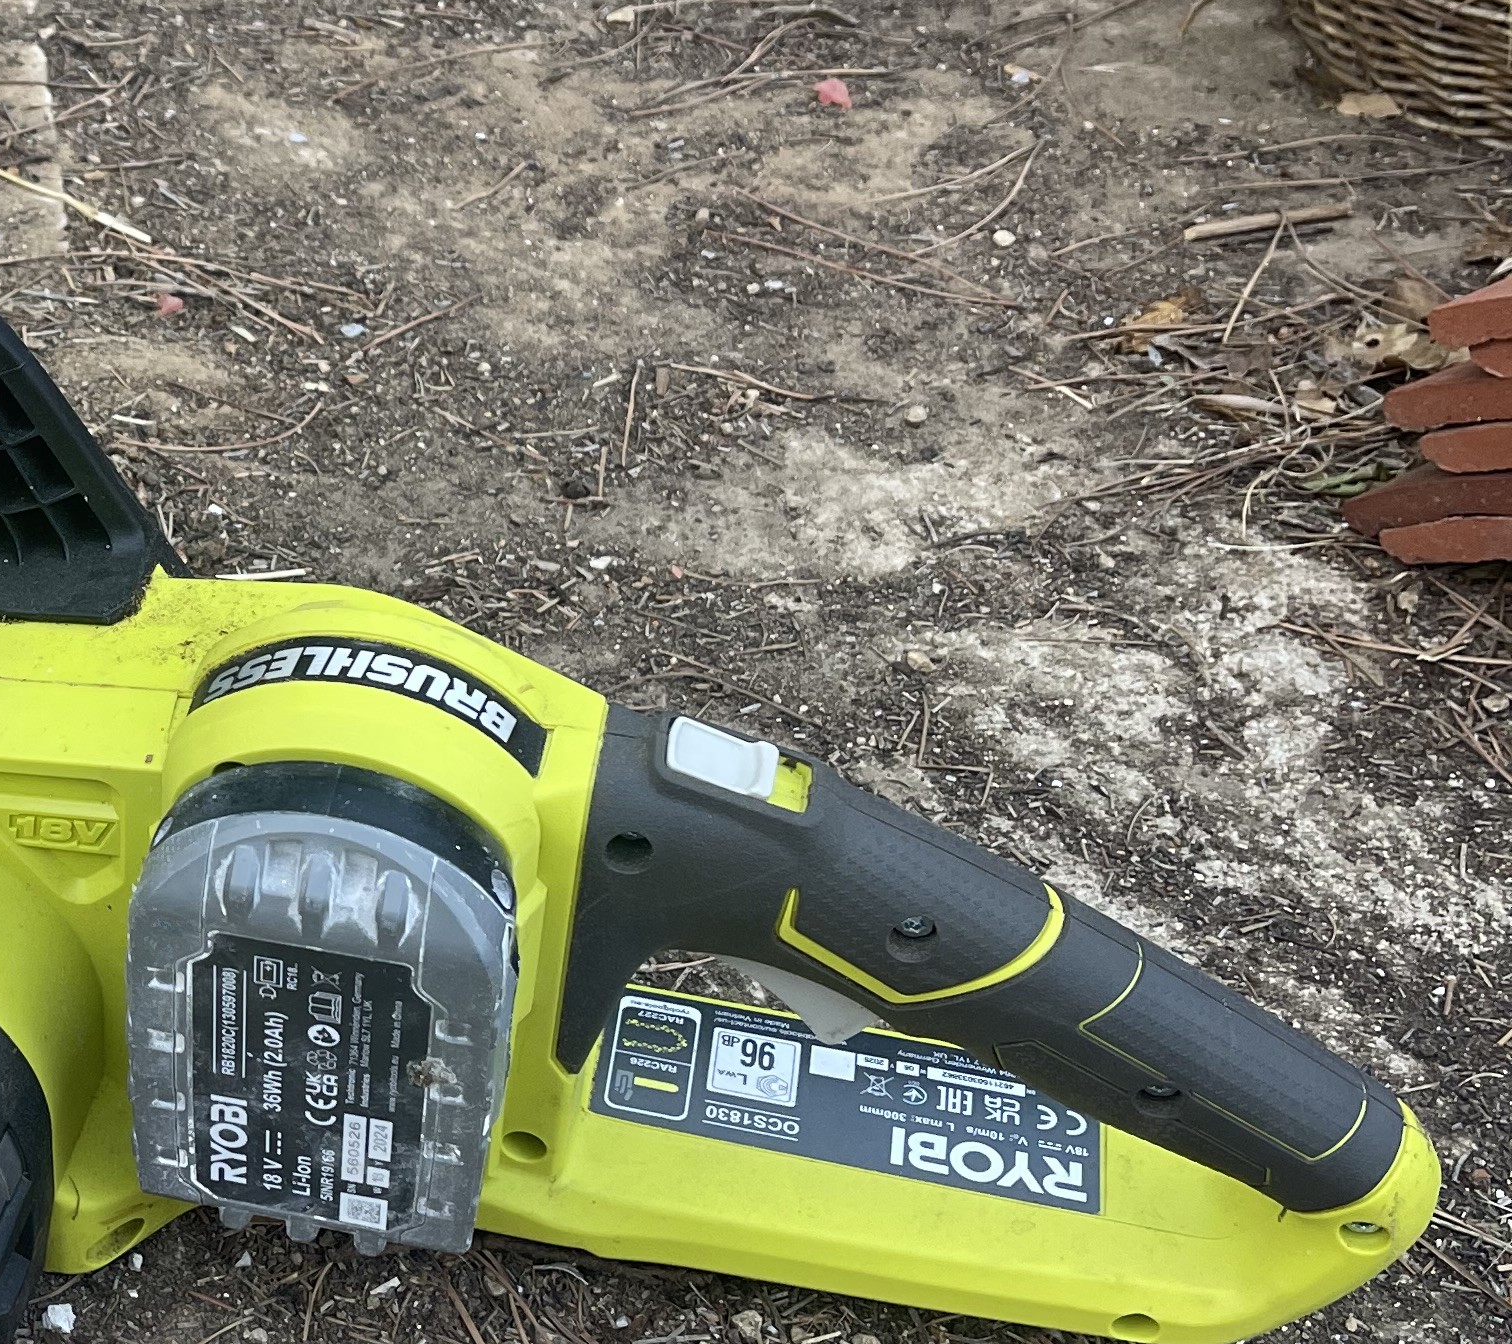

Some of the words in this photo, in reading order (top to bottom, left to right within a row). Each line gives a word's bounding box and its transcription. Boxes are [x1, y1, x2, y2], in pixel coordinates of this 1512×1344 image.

[202, 646, 517, 743] BRUSHLESS
[10, 814, 113, 848] 18V
[392, 1001, 403, 1020] China
[638, 1010, 684, 1024] RAC227
[715, 1009, 752, 1022] Vietnam
[764, 1018, 790, 1028] Made
[264, 1012, 289, 1067] (2.0Ah)
[391, 1029, 401, 1048] Made
[721, 1034, 740, 1048] dB
[741, 1039, 775, 1070] 96
[897, 1050, 939, 1063] Germany
[629, 1056, 677, 1073] RAC226
[263, 1071, 282, 1112] 36Wh
[360, 1074, 370, 1108] Industries
[705, 1105, 800, 1135] OCS1830
[859, 1105, 907, 1122] 300mm
[910, 1115, 942, 1128] max:
[985, 1107, 1020, 1125] UK
[946, 1122, 955, 1132] L
[966, 1126, 1005, 1141] 10m/s
[210, 1094, 248, 1184] RYOBI
[373, 1125, 388, 1152] 2024
[346, 1122, 361, 1175] 560526
[1065, 1144, 1089, 1156] 18V
[263, 1157, 282, 1169] V
[890, 1126, 1088, 1202] RYOBI
[263, 1174, 282, 1190] 18
[292, 1156, 311, 1196] Li-Ion
[320, 1149, 335, 1201] 5INR19/66
